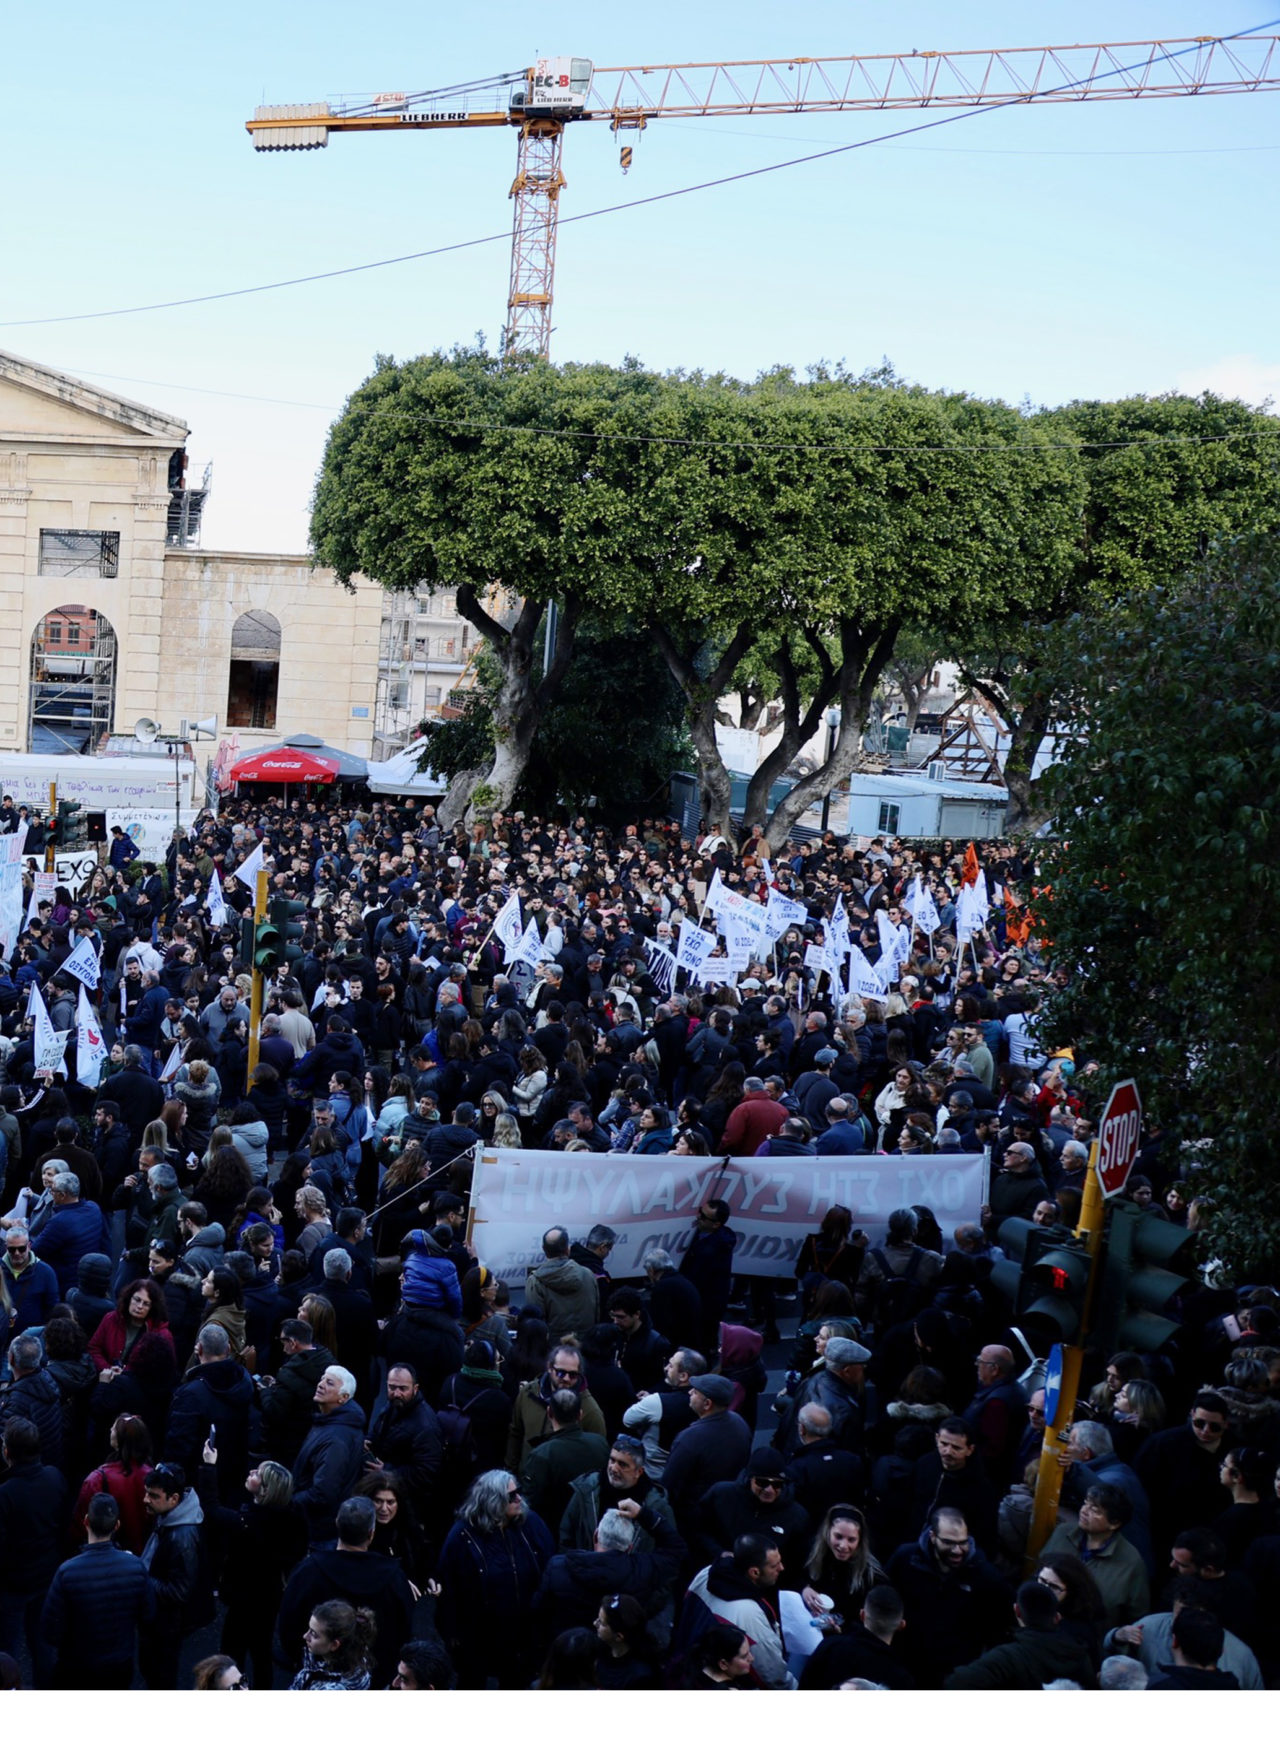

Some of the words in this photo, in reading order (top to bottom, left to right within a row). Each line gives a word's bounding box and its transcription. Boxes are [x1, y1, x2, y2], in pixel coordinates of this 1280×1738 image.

[535, 75, 570, 88] EC-B
[402, 112, 467, 122] LIEBHERR
[1101, 1110, 1138, 1173] STOP
